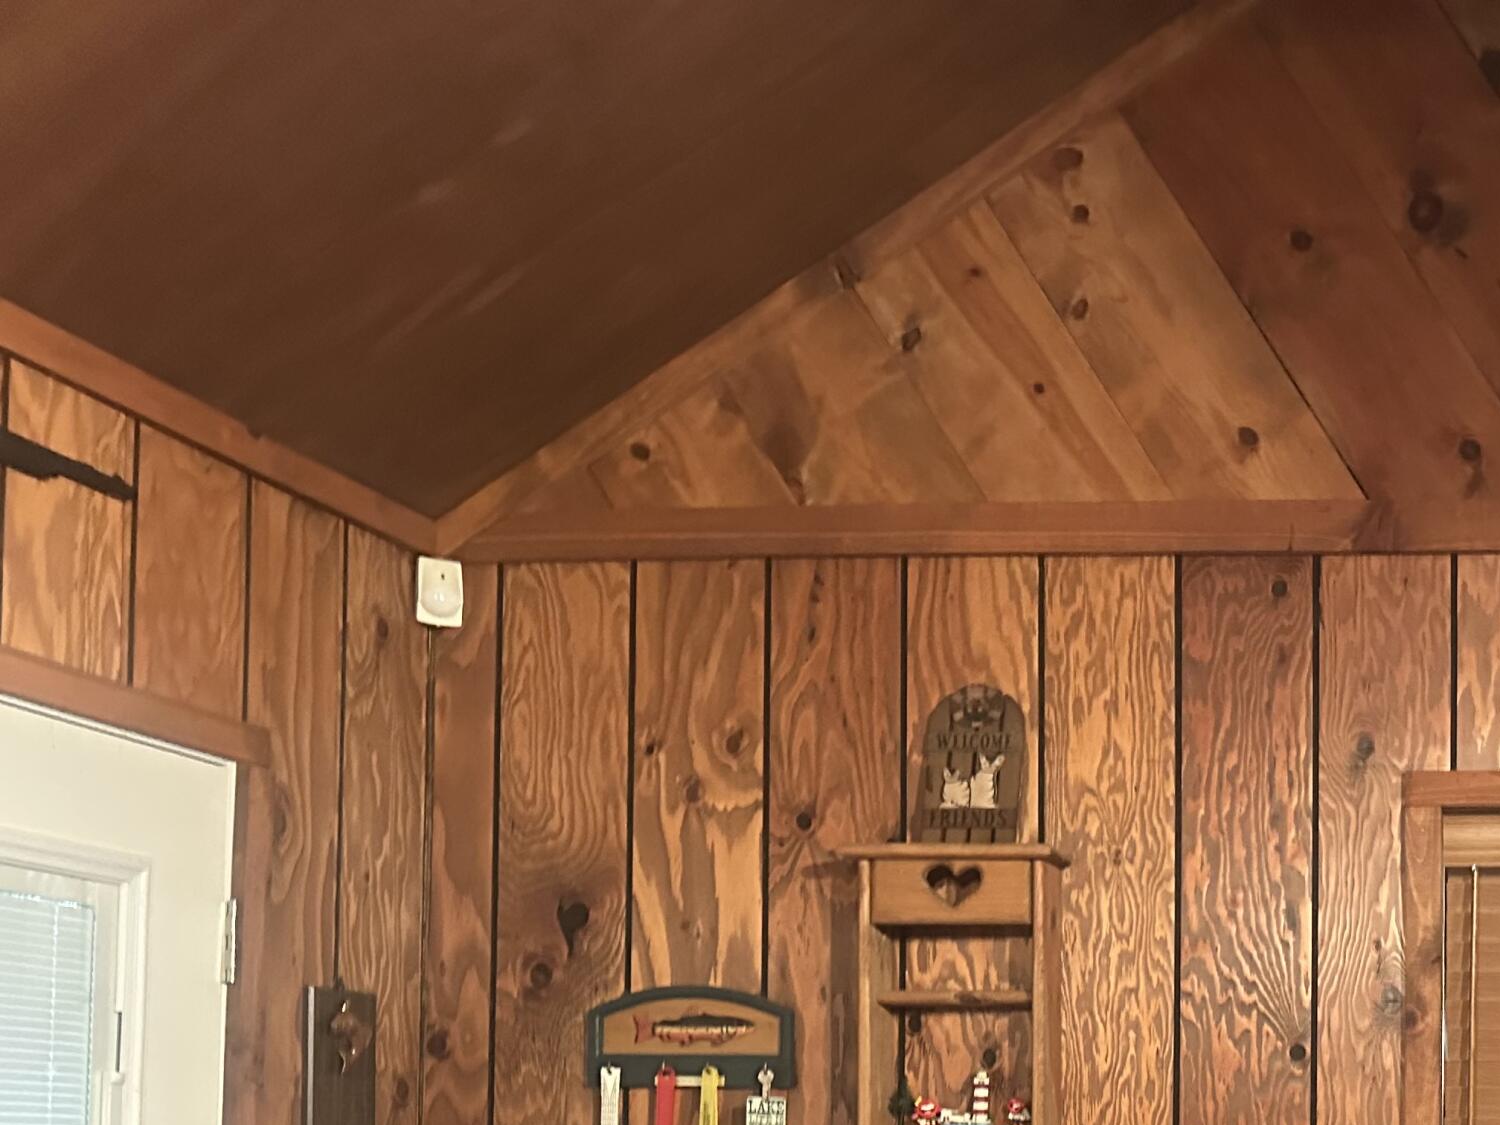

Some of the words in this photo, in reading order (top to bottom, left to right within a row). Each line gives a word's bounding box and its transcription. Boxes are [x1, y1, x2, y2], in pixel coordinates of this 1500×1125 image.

[937, 733, 1011, 750] WELCOME
[929, 809, 1007, 828] FRIENDS
[748, 1099, 785, 1115] LAKE
